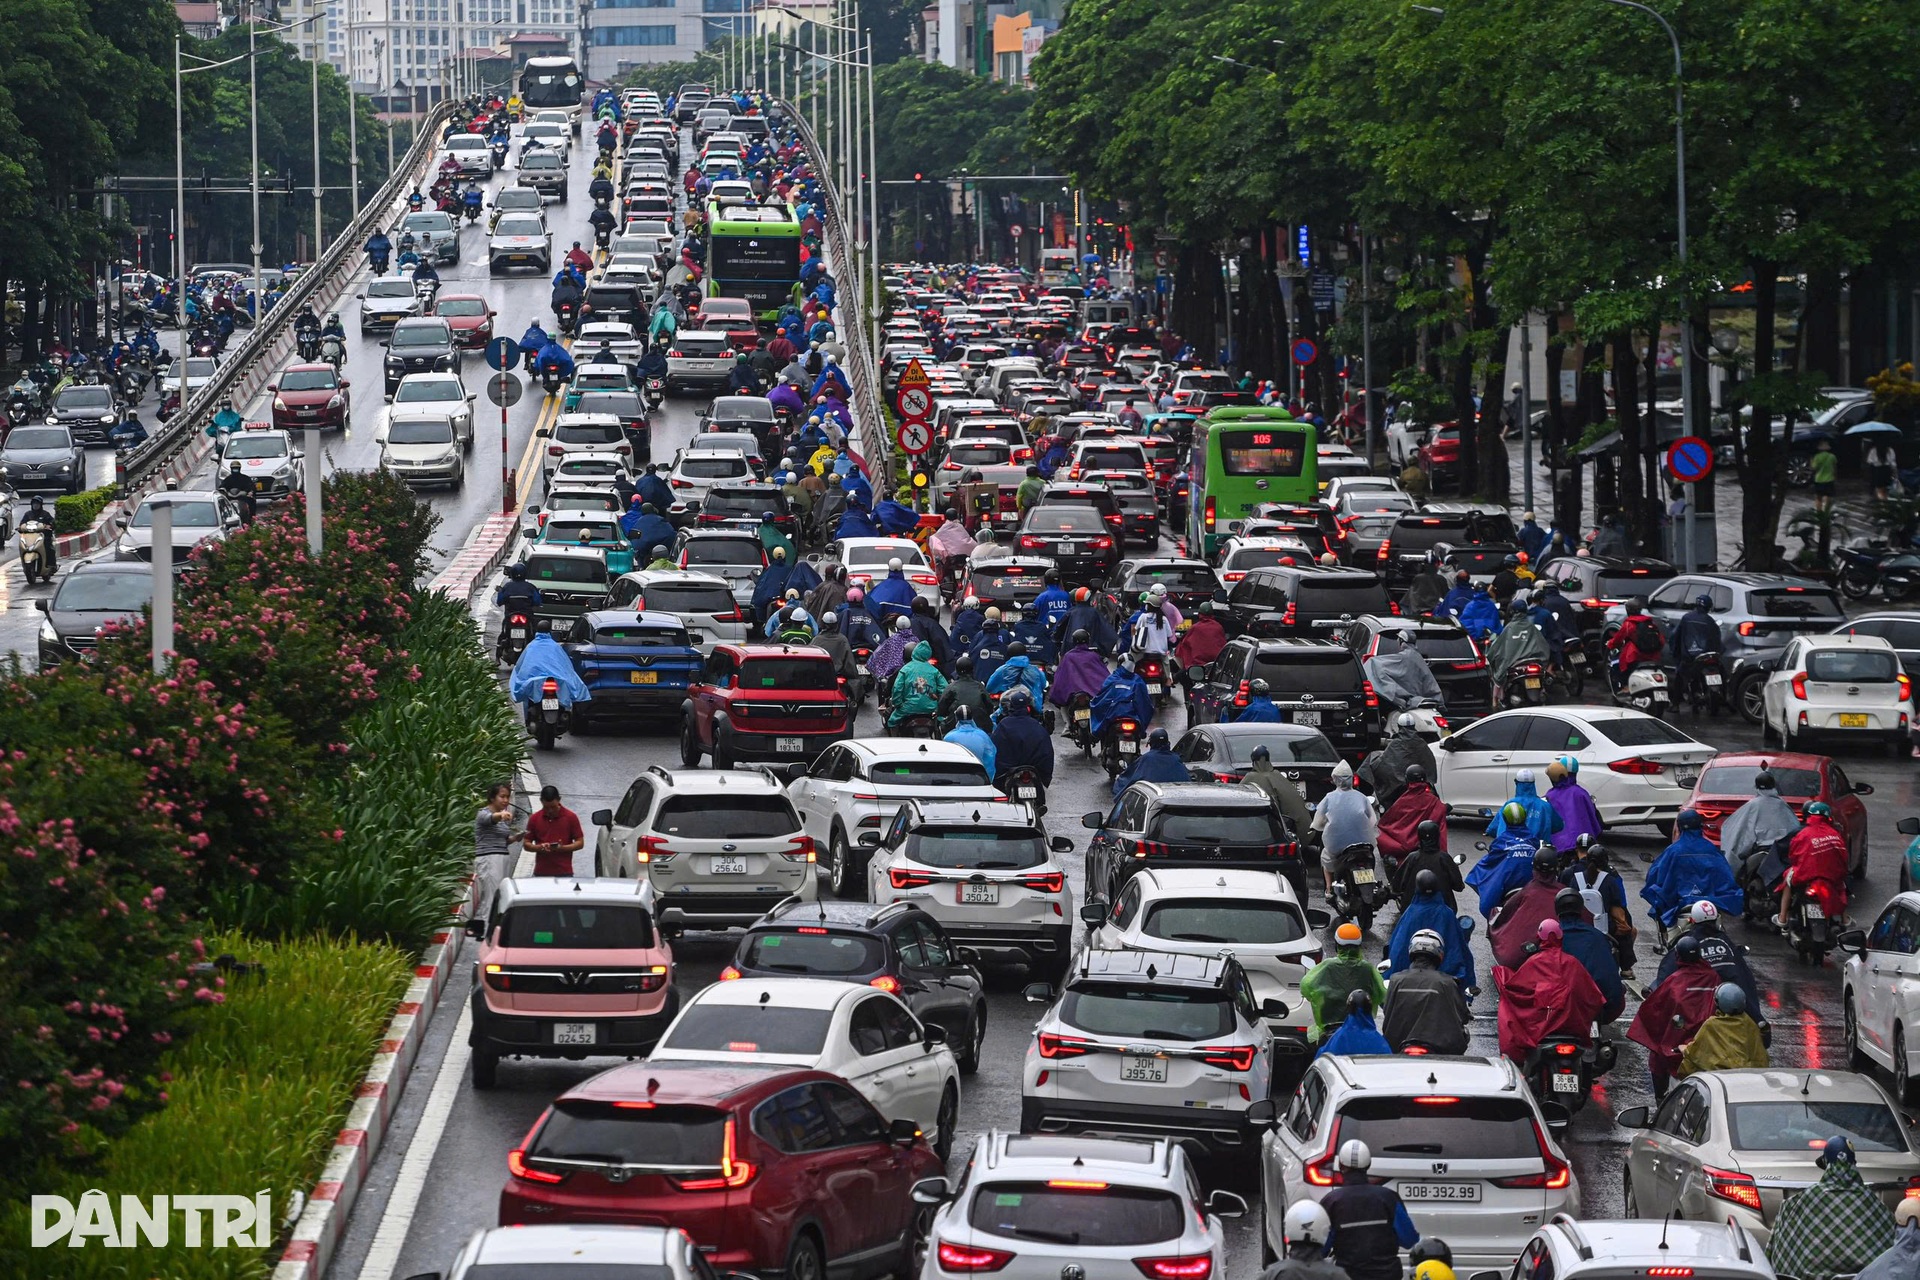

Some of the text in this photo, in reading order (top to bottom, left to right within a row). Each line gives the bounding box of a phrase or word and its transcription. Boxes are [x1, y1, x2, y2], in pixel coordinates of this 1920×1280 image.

[1253, 434, 1271, 444] 105
[1048, 600, 1068, 609] PLUS
[721, 856, 737, 864] 30K
[715, 864, 744, 873] 256.40
[971, 884, 988, 893] 89A
[965, 893, 994, 902] 350.21
[1701, 945, 1727, 957] LEO
[565, 1024, 584, 1034] 30M
[558, 1034, 592, 1044] 024.52
[1134, 1058, 1155, 1069] 30H
[1126, 1068, 1162, 1080] 395.76
[1404, 1186, 1475, 1198] 30B-392.99
